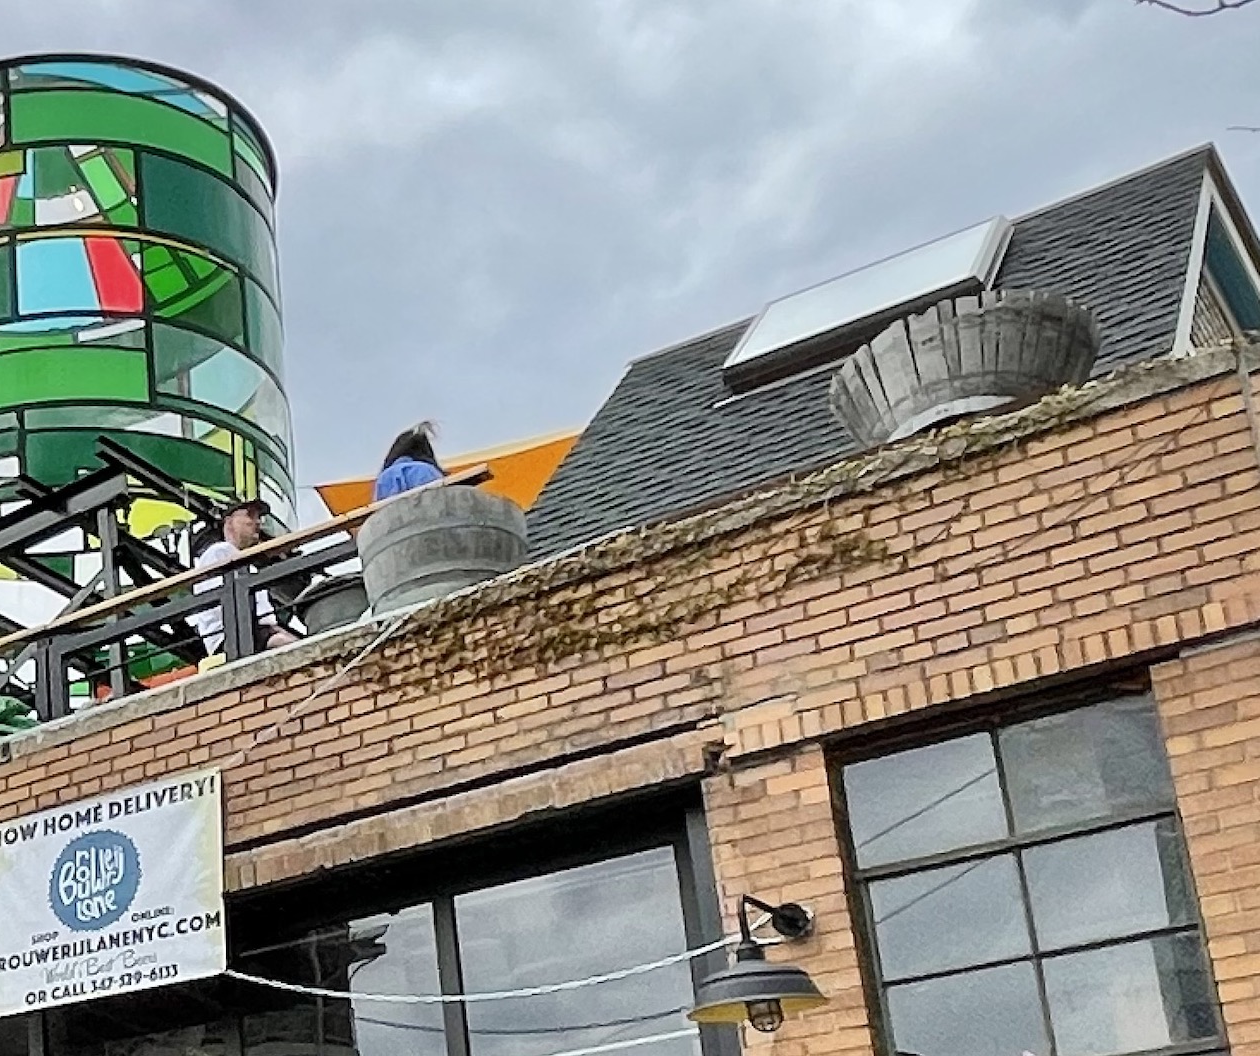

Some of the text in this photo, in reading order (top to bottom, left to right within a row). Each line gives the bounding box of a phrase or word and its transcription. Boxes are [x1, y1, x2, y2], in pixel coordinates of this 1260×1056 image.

[43, 803, 103, 836] HOME
[108, 775, 215, 820] DELIVERY!
[25, 990, 48, 1005] OR
[51, 981, 87, 1001] CALL
